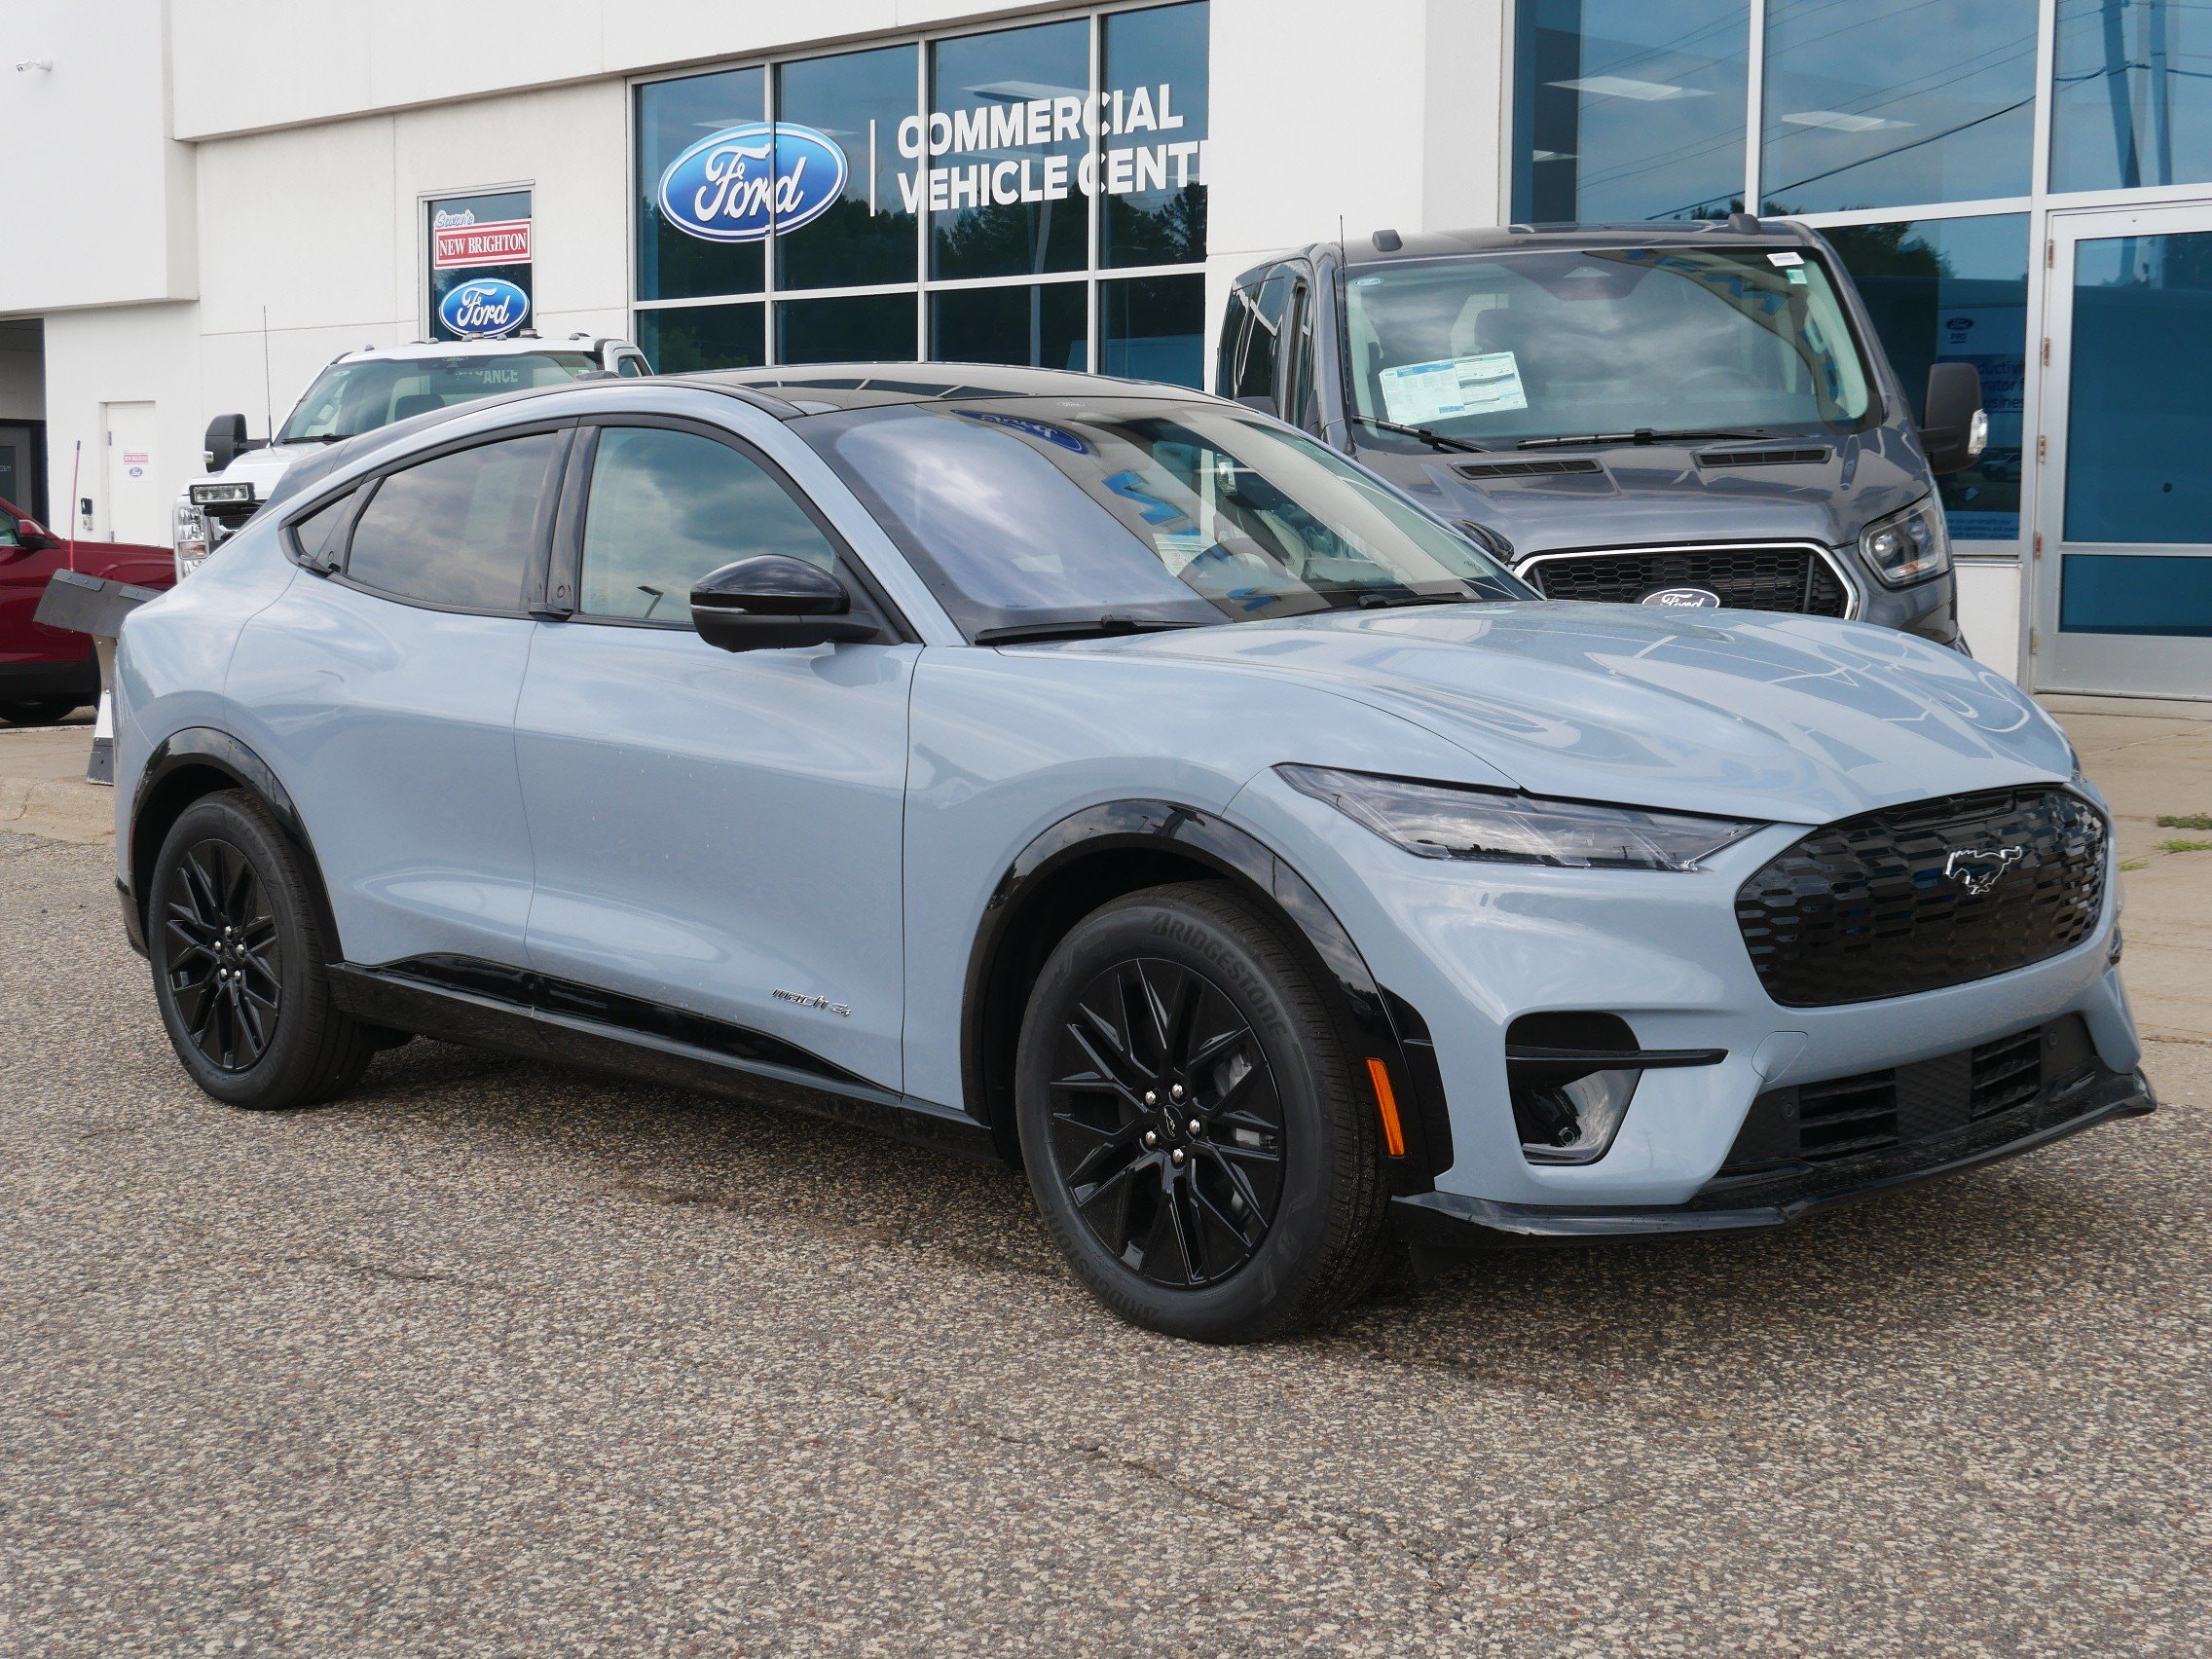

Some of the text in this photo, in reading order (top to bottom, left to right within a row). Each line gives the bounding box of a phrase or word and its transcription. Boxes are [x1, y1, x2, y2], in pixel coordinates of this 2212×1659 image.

[898, 84, 1183, 159] COMMERCIAL
[694, 143, 807, 222] Ford
[897, 155, 1068, 214] VEHICLE
[439, 233, 527, 256] NEW BRIGHTON
[457, 287, 511, 327] Ford
[1150, 912, 1287, 1040] BRIDGESTONE
